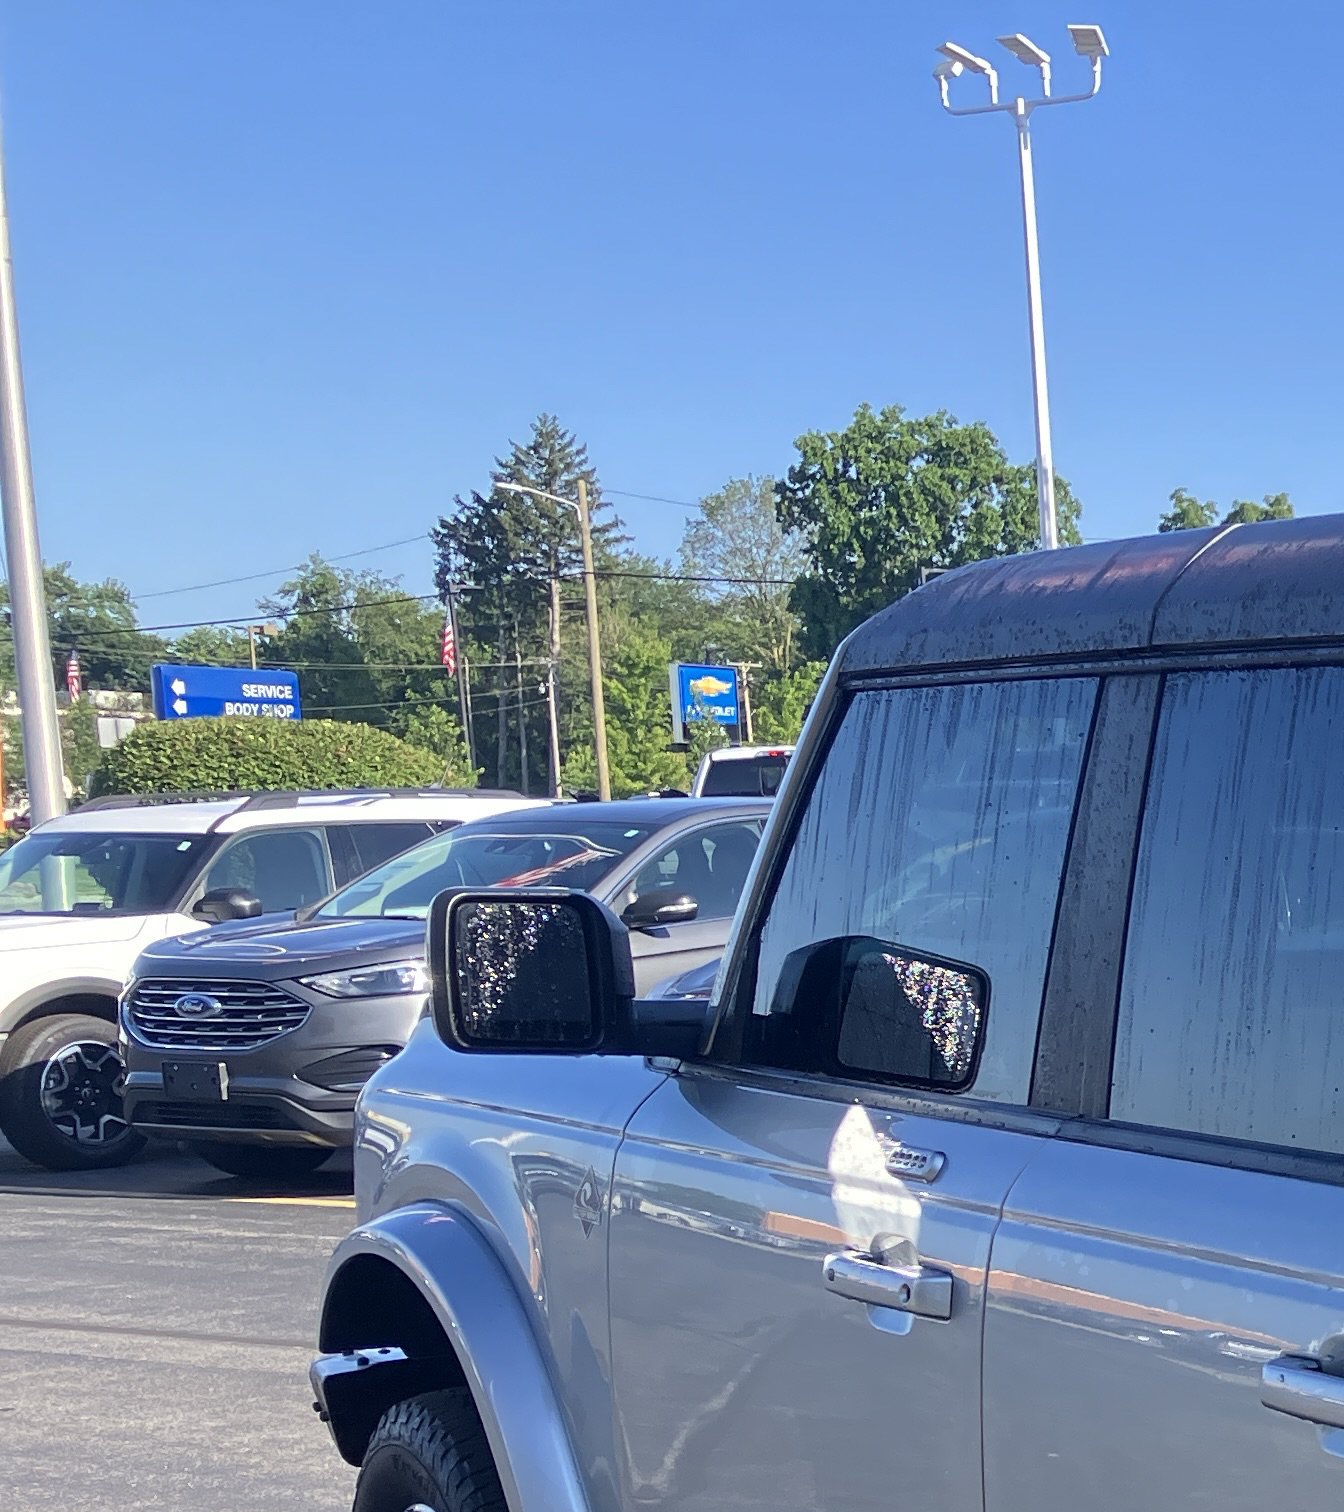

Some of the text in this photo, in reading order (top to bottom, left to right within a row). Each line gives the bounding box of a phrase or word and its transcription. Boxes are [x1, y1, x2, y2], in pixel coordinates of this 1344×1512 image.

[242, 684, 293, 699] SERVICE
[225, 702, 294, 718] BODY SHOP
